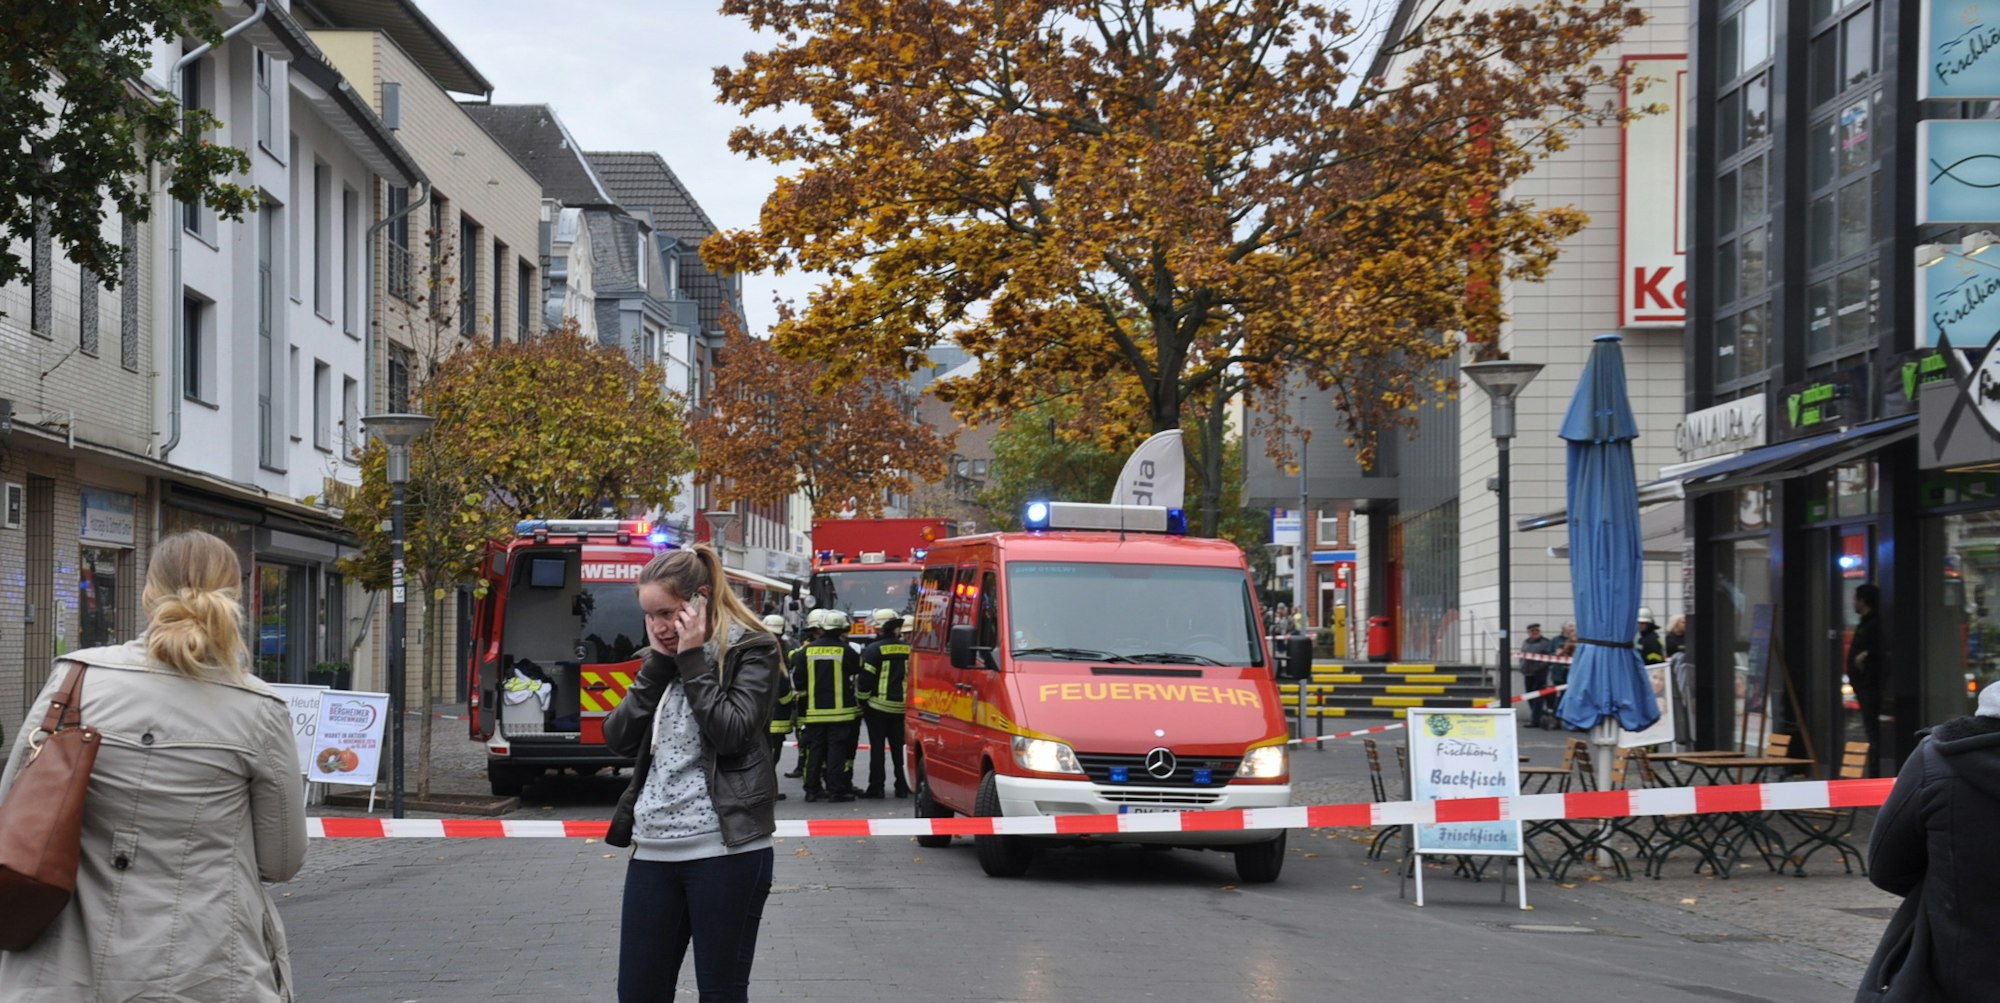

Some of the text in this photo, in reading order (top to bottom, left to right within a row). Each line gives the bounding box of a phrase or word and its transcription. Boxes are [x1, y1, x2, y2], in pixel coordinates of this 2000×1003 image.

[581, 564, 643, 579] WEHR
[1039, 682, 1262, 709] FEUERWEHR
[329, 706, 369, 717] BERGHEIMER
[1437, 742, 1498, 762] Fischkönig
[1430, 769, 1507, 790] Backfisch
[1439, 827, 1508, 844] Frischfisch
